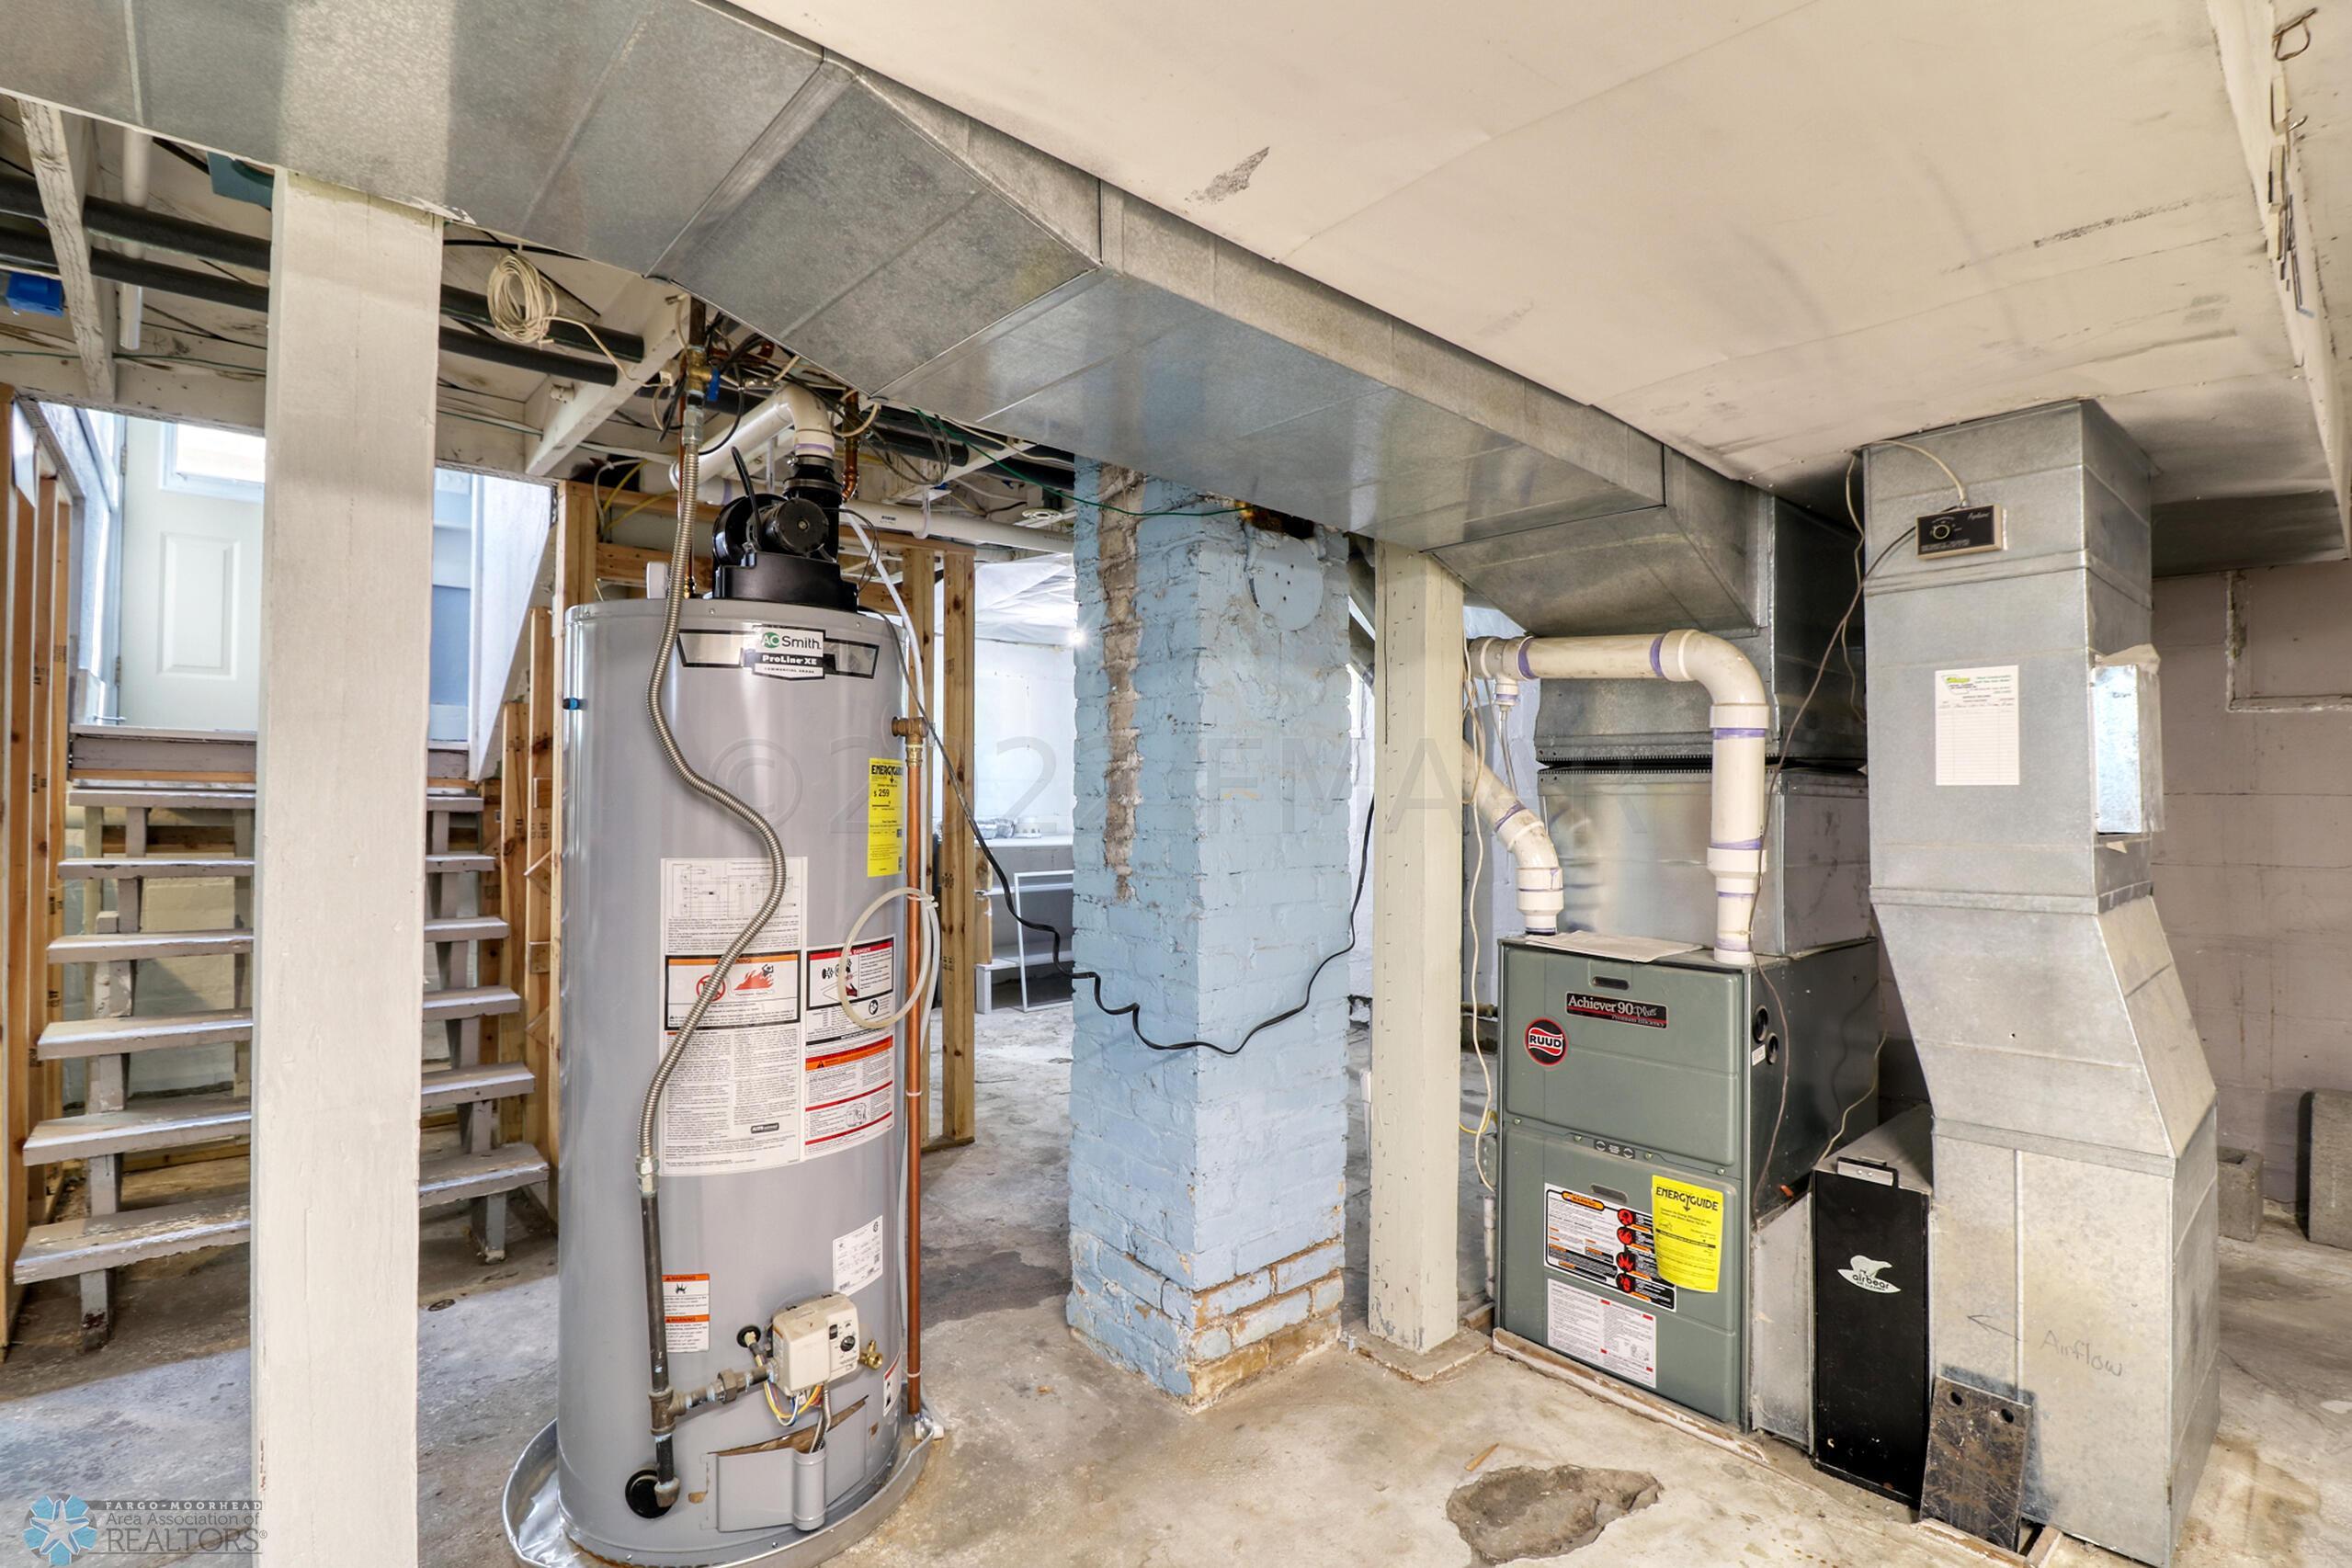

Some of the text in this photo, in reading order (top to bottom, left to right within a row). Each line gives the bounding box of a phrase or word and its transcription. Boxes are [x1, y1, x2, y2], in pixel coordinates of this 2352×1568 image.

[781, 635, 822, 650] Smith
[762, 653, 817, 665] ProLine XE
[879, 788, 890, 797] 259
[1567, 994, 1617, 1013] Achiever
[1617, 1001, 1634, 1016] 90
[1529, 1034, 1562, 1049] RUUD
[1655, 1186, 1719, 1211] ENERGYGUIDE
[1852, 1273, 1890, 1290] airbear
[2039, 1329, 2123, 1378] Airflow
